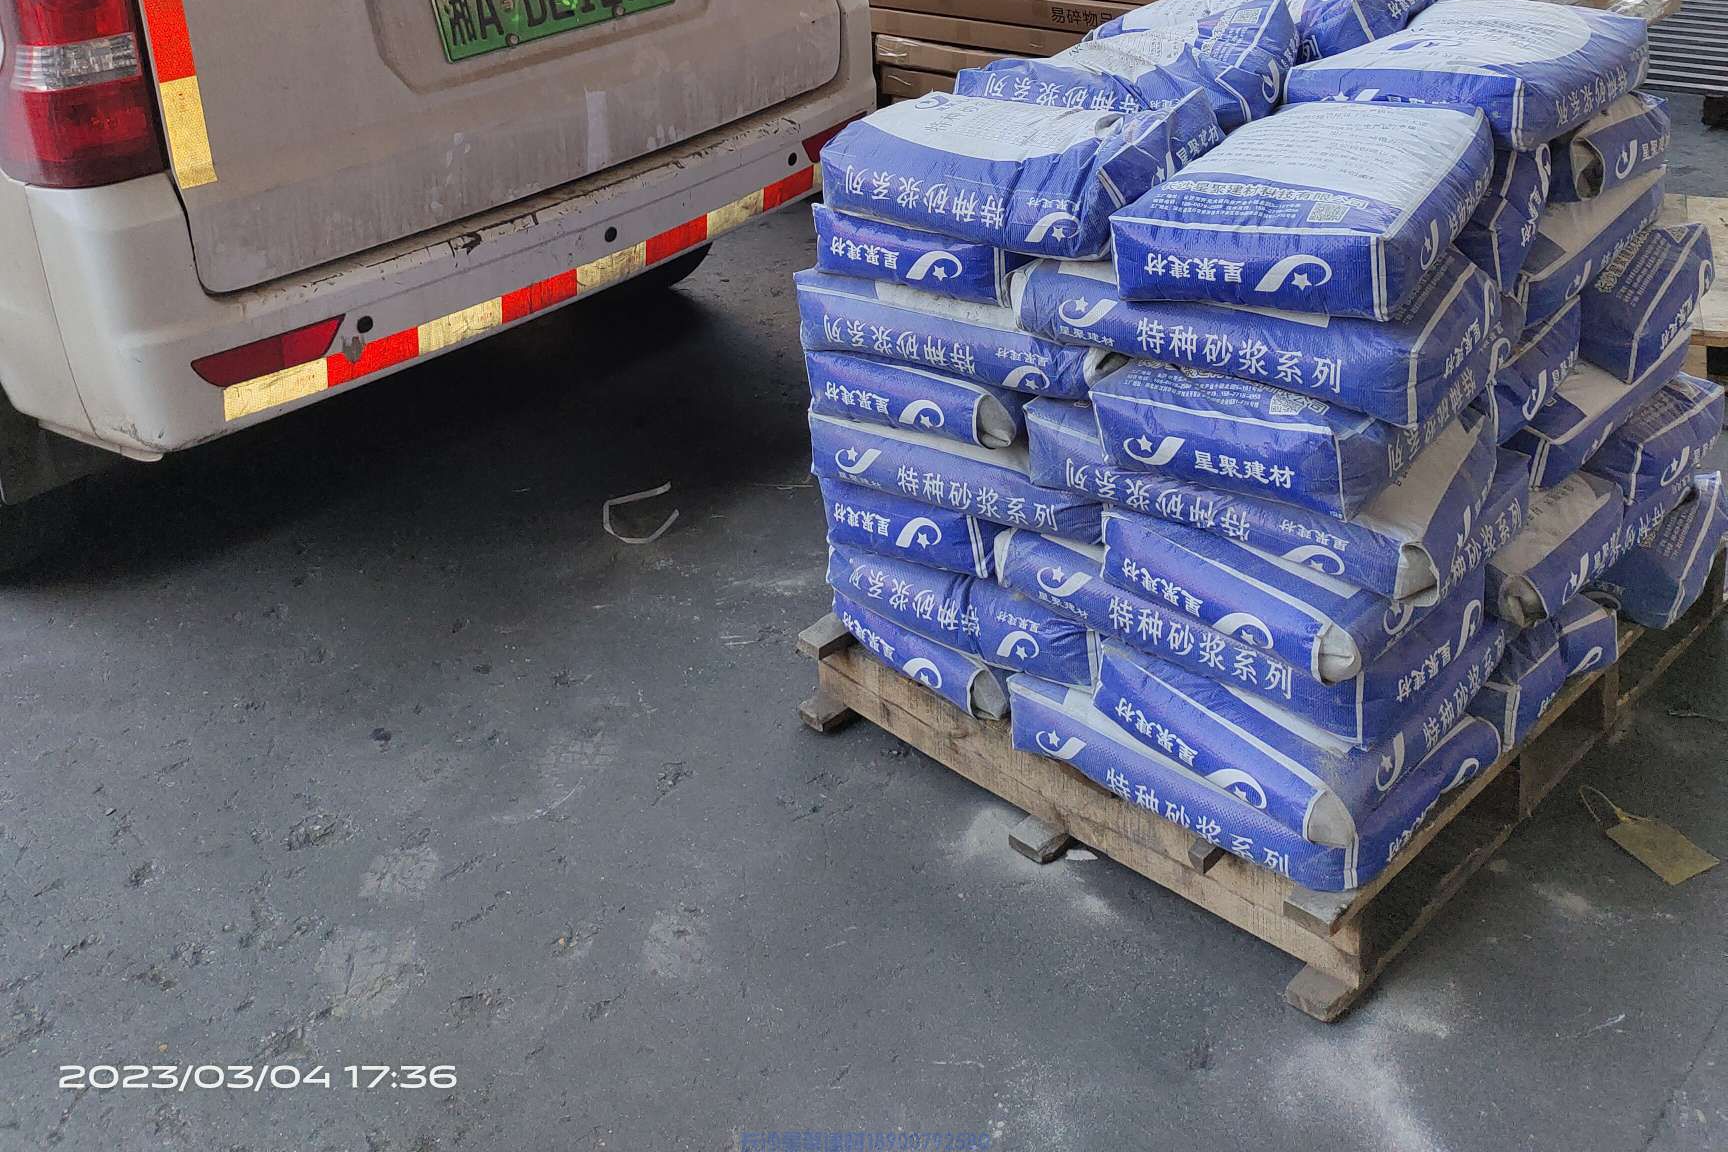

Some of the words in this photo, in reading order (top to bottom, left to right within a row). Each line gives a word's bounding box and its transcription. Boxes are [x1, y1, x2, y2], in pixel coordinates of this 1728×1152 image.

[845, 164, 1004, 228] 特种砂浆系列
[830, 233, 899, 270] 星聚建材
[1145, 252, 1245, 284] 星聚建材
[824, 314, 975, 375] 特种砂浆系列
[1137, 316, 1343, 395] 特种砂浆系列
[825, 381, 890, 416] 星聚建材
[897, 464, 1058, 532] 特种砂浆系列
[1194, 450, 1296, 490] 星聚建材
[834, 502, 891, 537] 星聚建材
[1121, 557, 1204, 616] 星聚建材
[1108, 597, 1294, 700] 特种砂浆系列
[1116, 697, 1198, 768] 星聚建材
[1106, 767, 1290, 877] 特种砂浆系列
